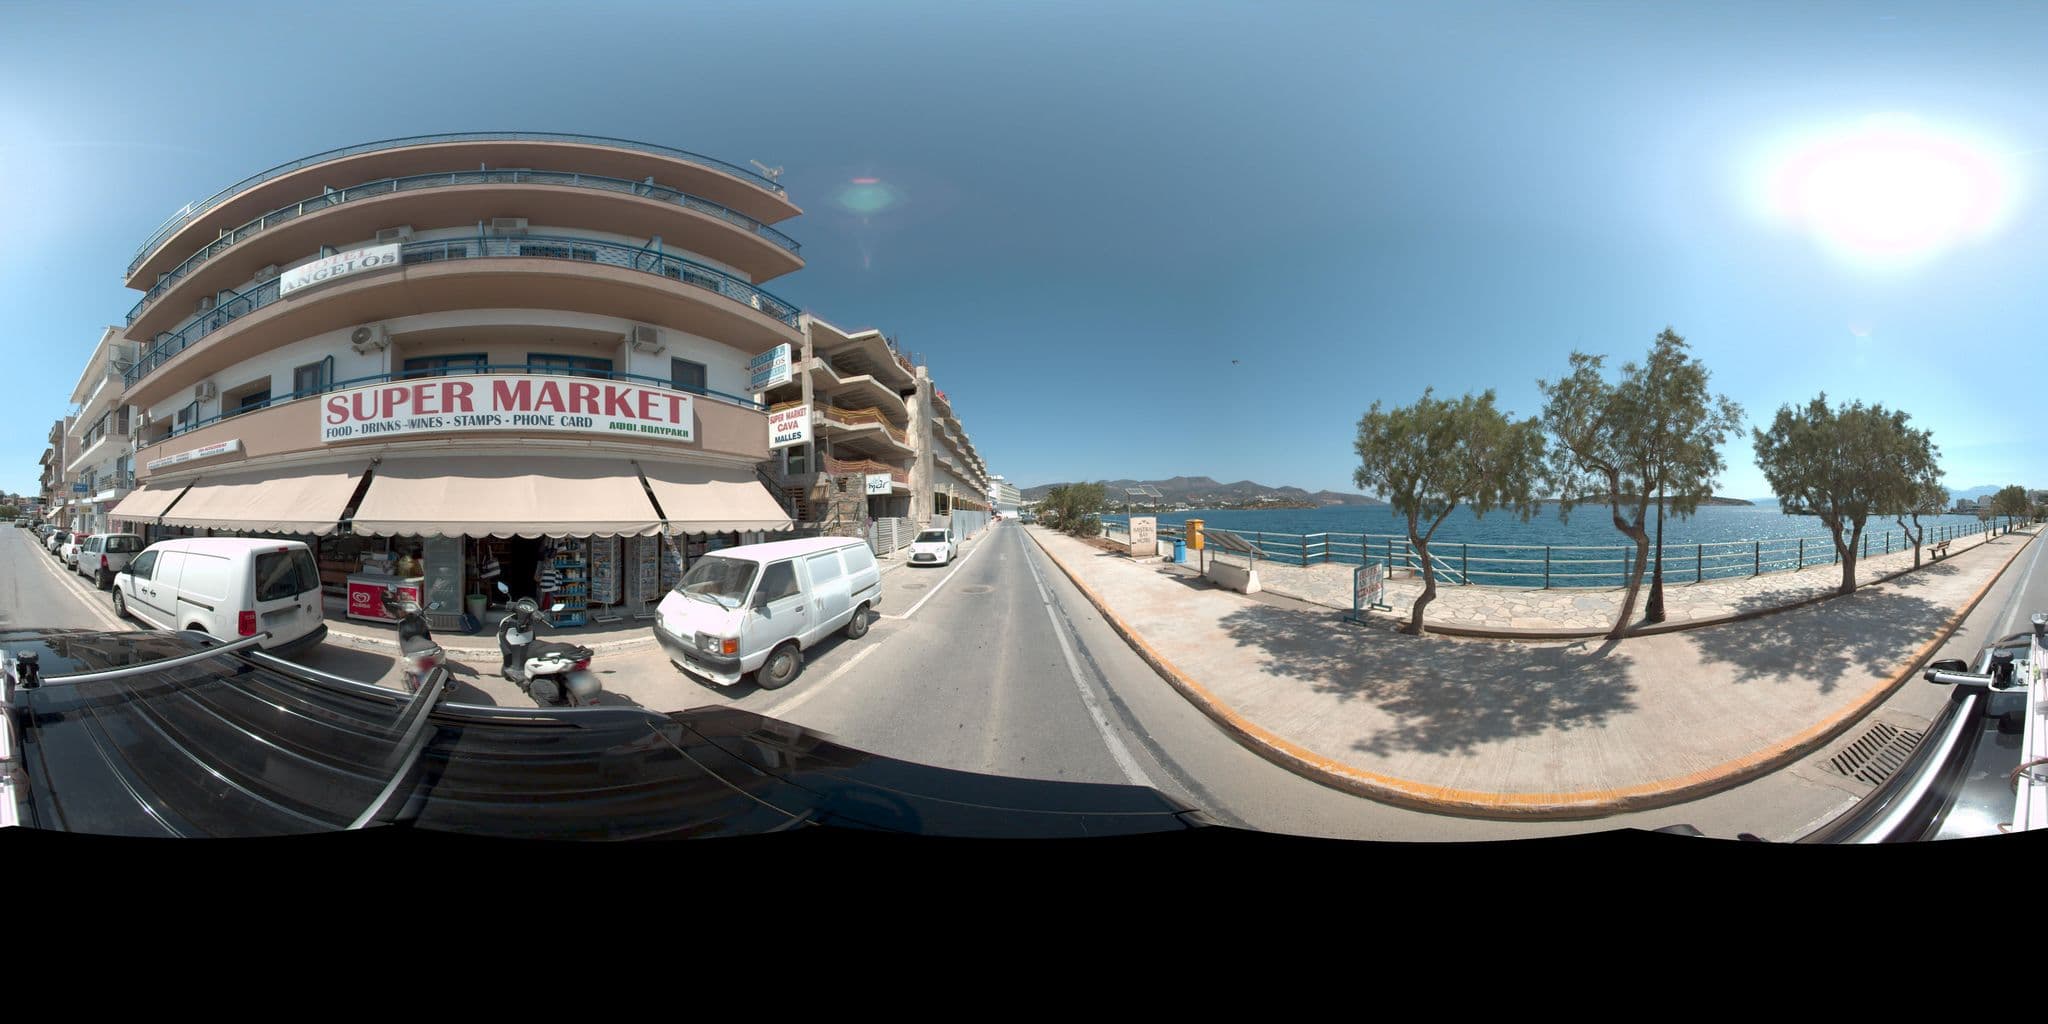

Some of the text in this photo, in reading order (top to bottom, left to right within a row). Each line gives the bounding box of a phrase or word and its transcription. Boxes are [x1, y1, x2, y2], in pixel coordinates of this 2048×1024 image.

[281, 253, 396, 292] ANGELOS
[327, 380, 687, 425] SUPER MARKET
[769, 407, 808, 424] SUPER MARKET
[326, 425, 353, 438] FOOD
[361, 420, 401, 434] DRINKS
[453, 414, 502, 427] STAMPS
[513, 414, 555, 426] PHONE
[561, 415, 593, 428] CARD
[777, 420, 799, 432] CAVA
[775, 432, 802, 444] MALLES
